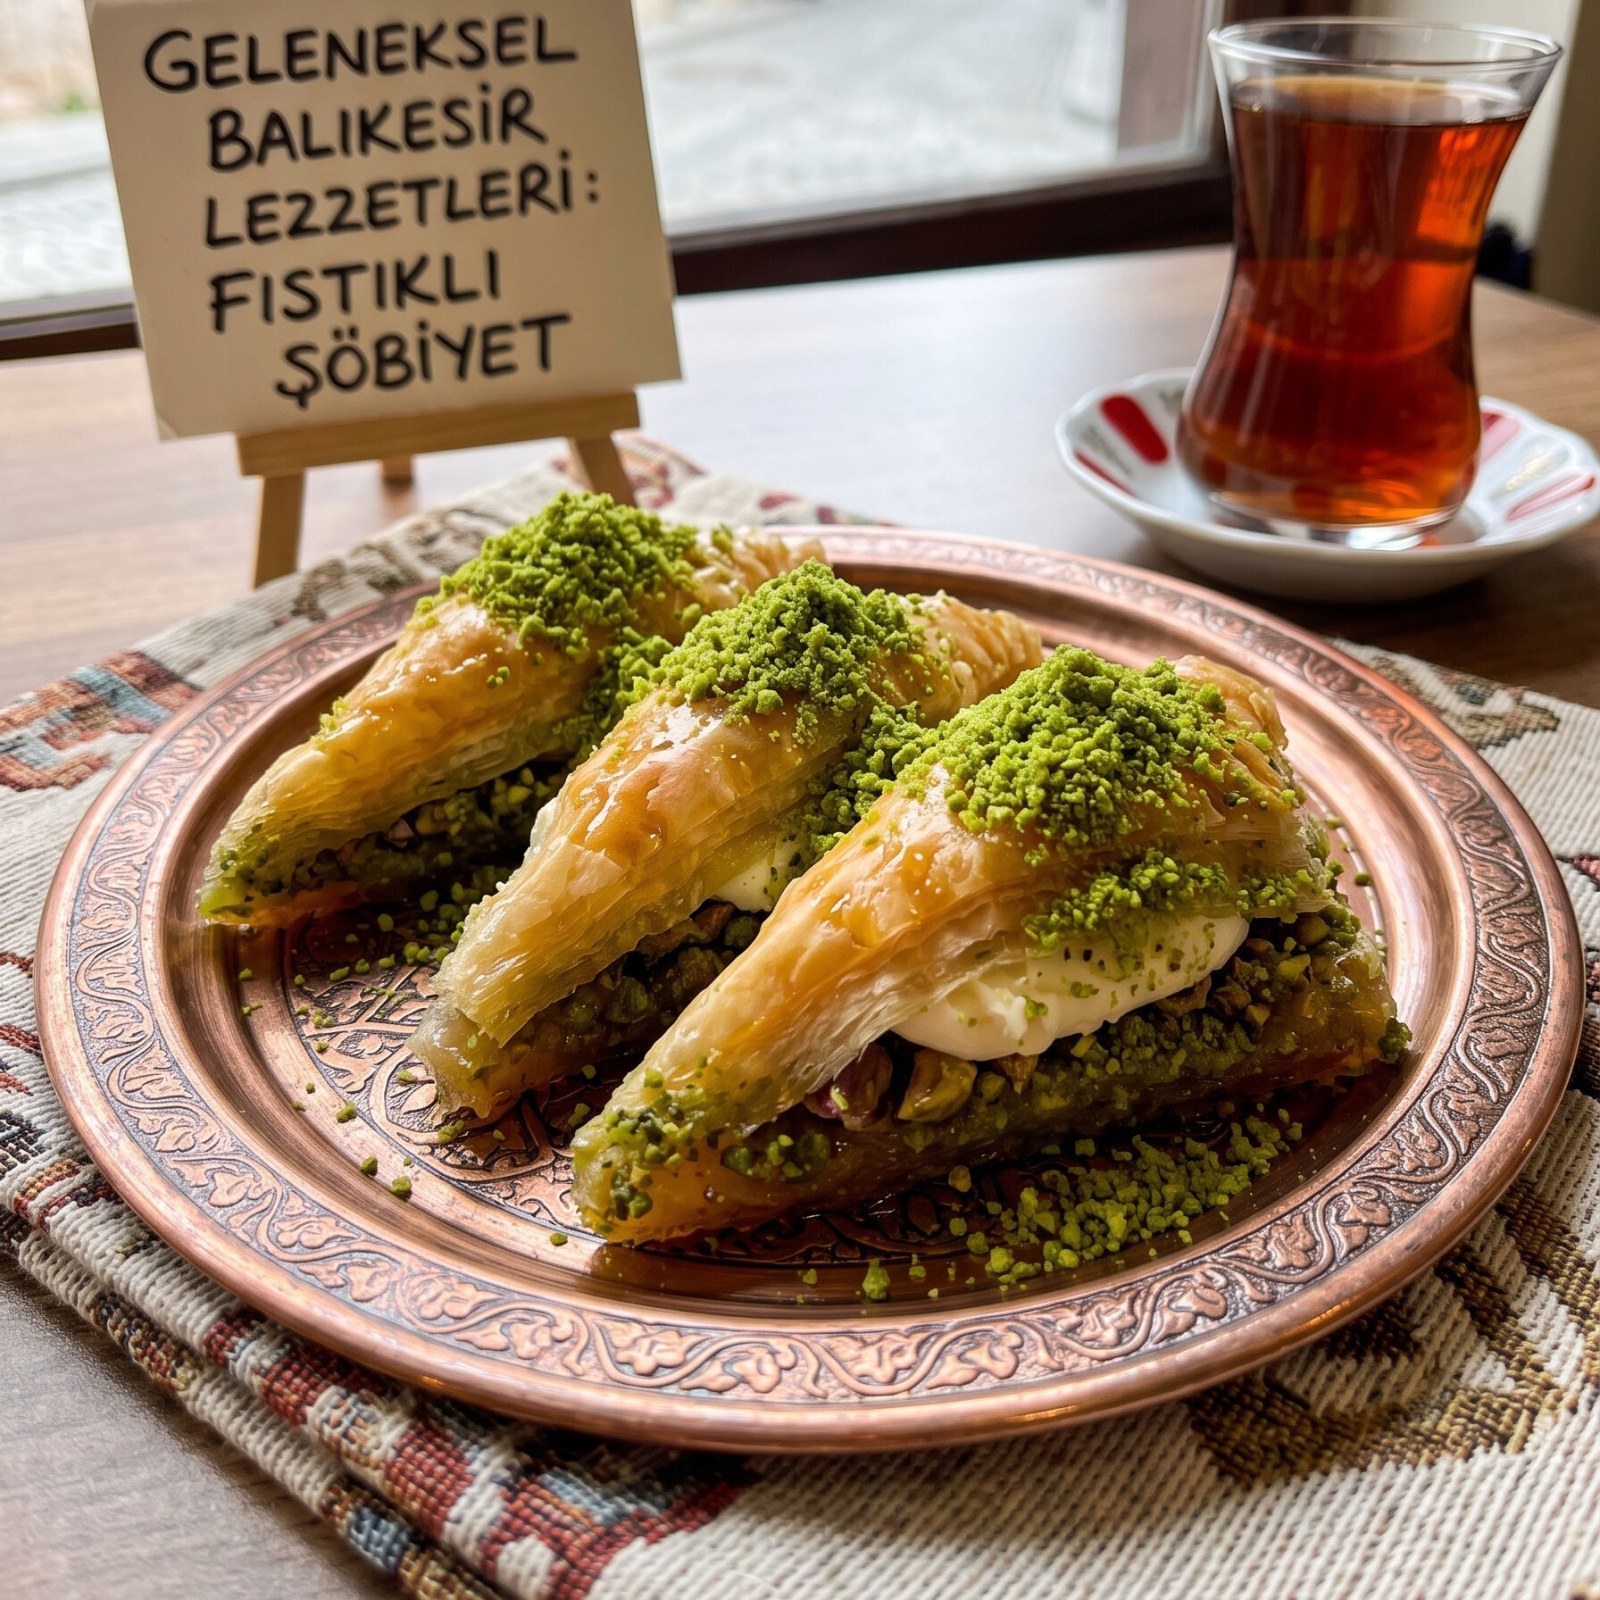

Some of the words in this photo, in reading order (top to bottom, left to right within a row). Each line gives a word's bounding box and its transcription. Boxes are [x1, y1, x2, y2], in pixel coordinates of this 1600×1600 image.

[142, 13, 581, 94] GELENEKSEL
[206, 80, 551, 174] BALIKESİR
[207, 248, 502, 335] FISTIKLI
[274, 312, 573, 412] ŞÖBİYET
